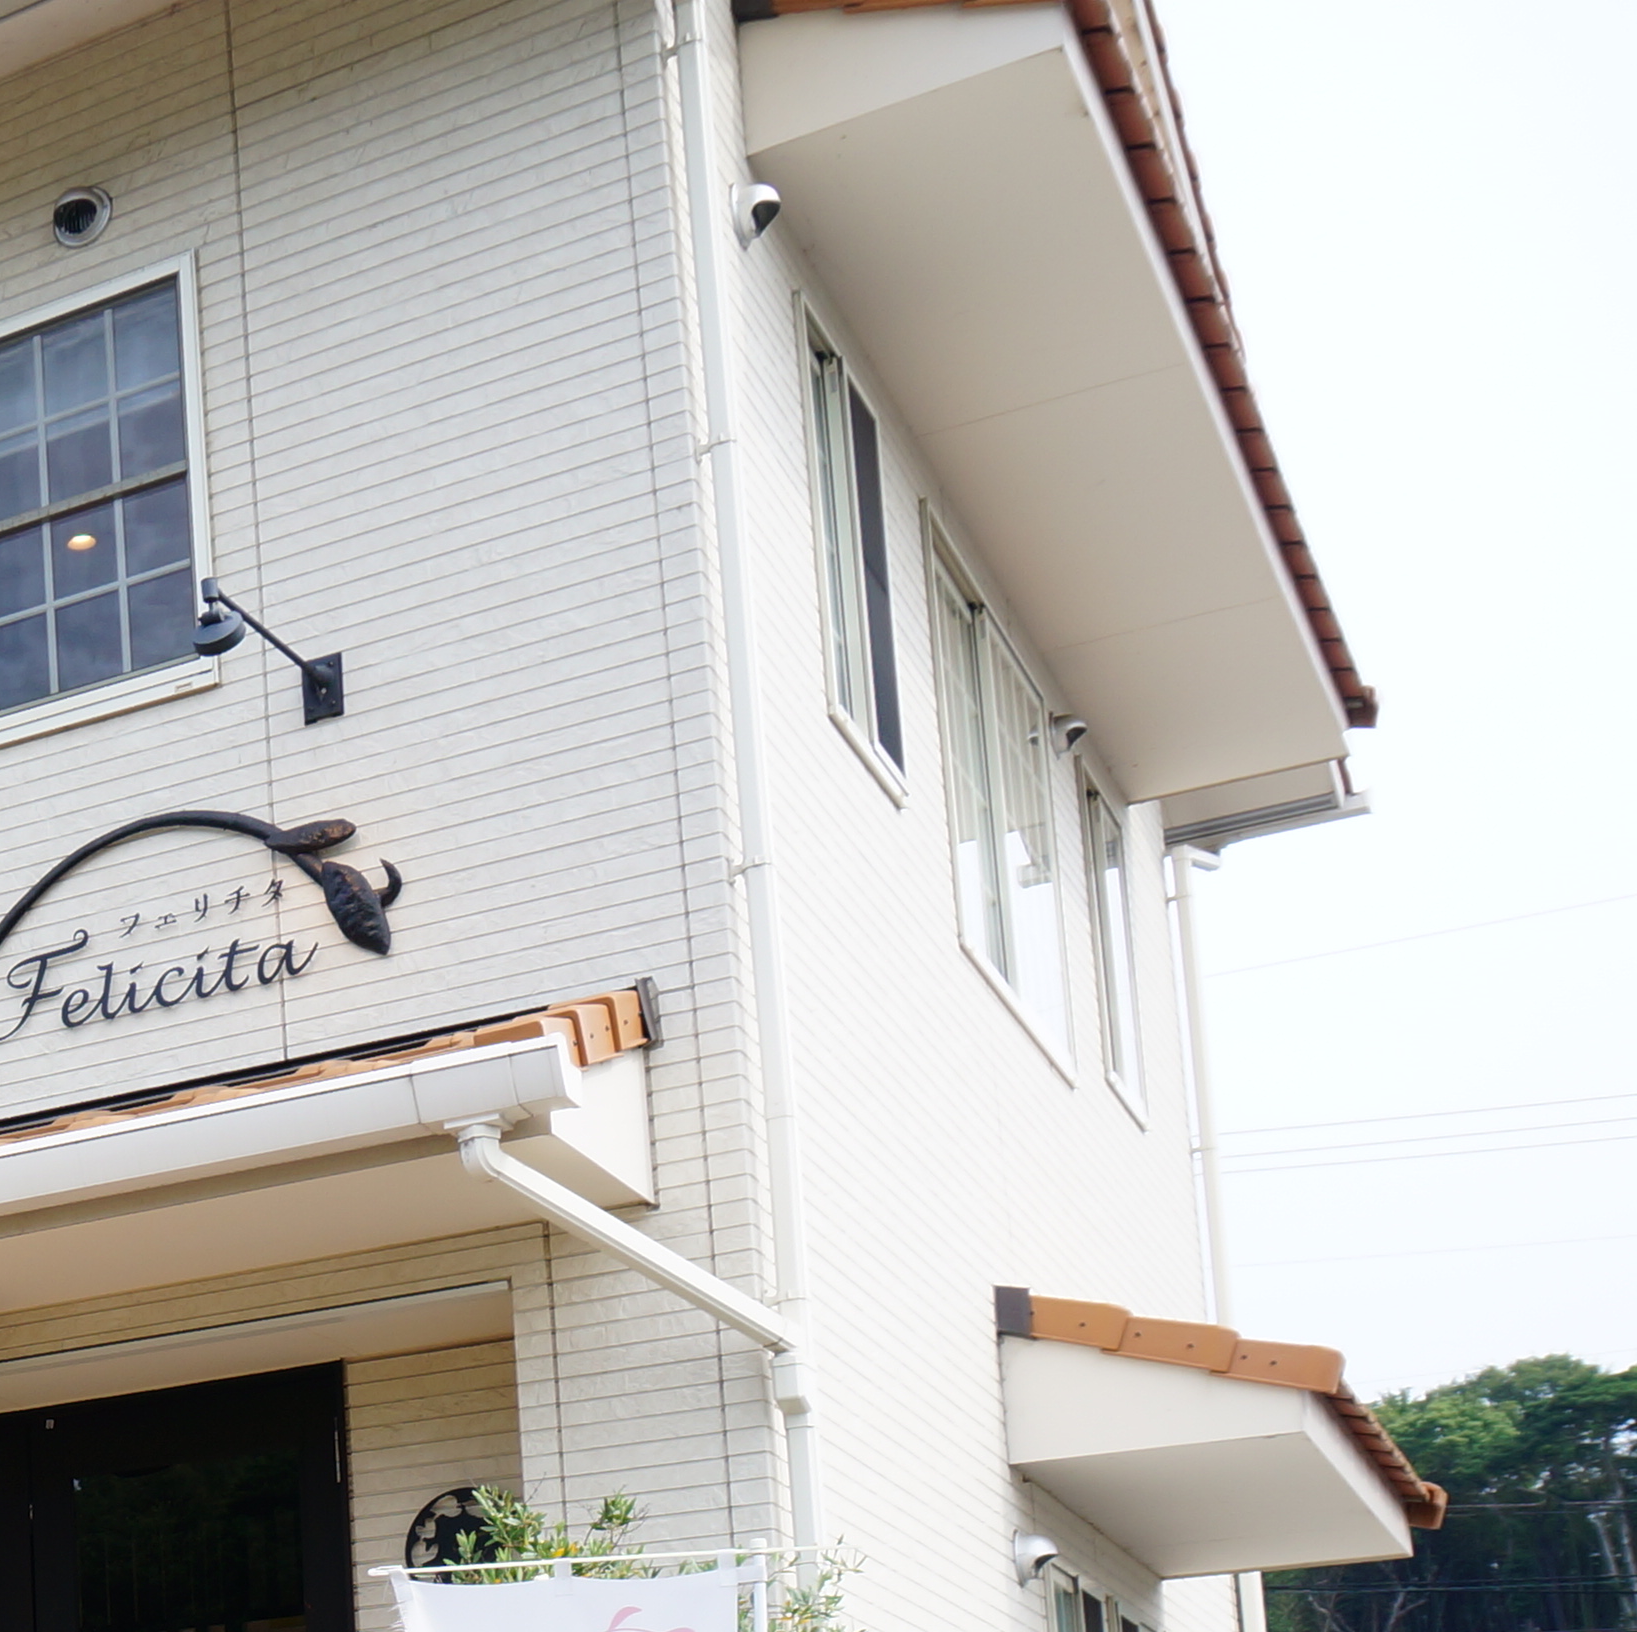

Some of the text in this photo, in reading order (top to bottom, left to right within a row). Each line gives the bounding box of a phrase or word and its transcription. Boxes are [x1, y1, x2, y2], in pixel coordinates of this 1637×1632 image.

[119, 880, 286, 938] フェリチタ
